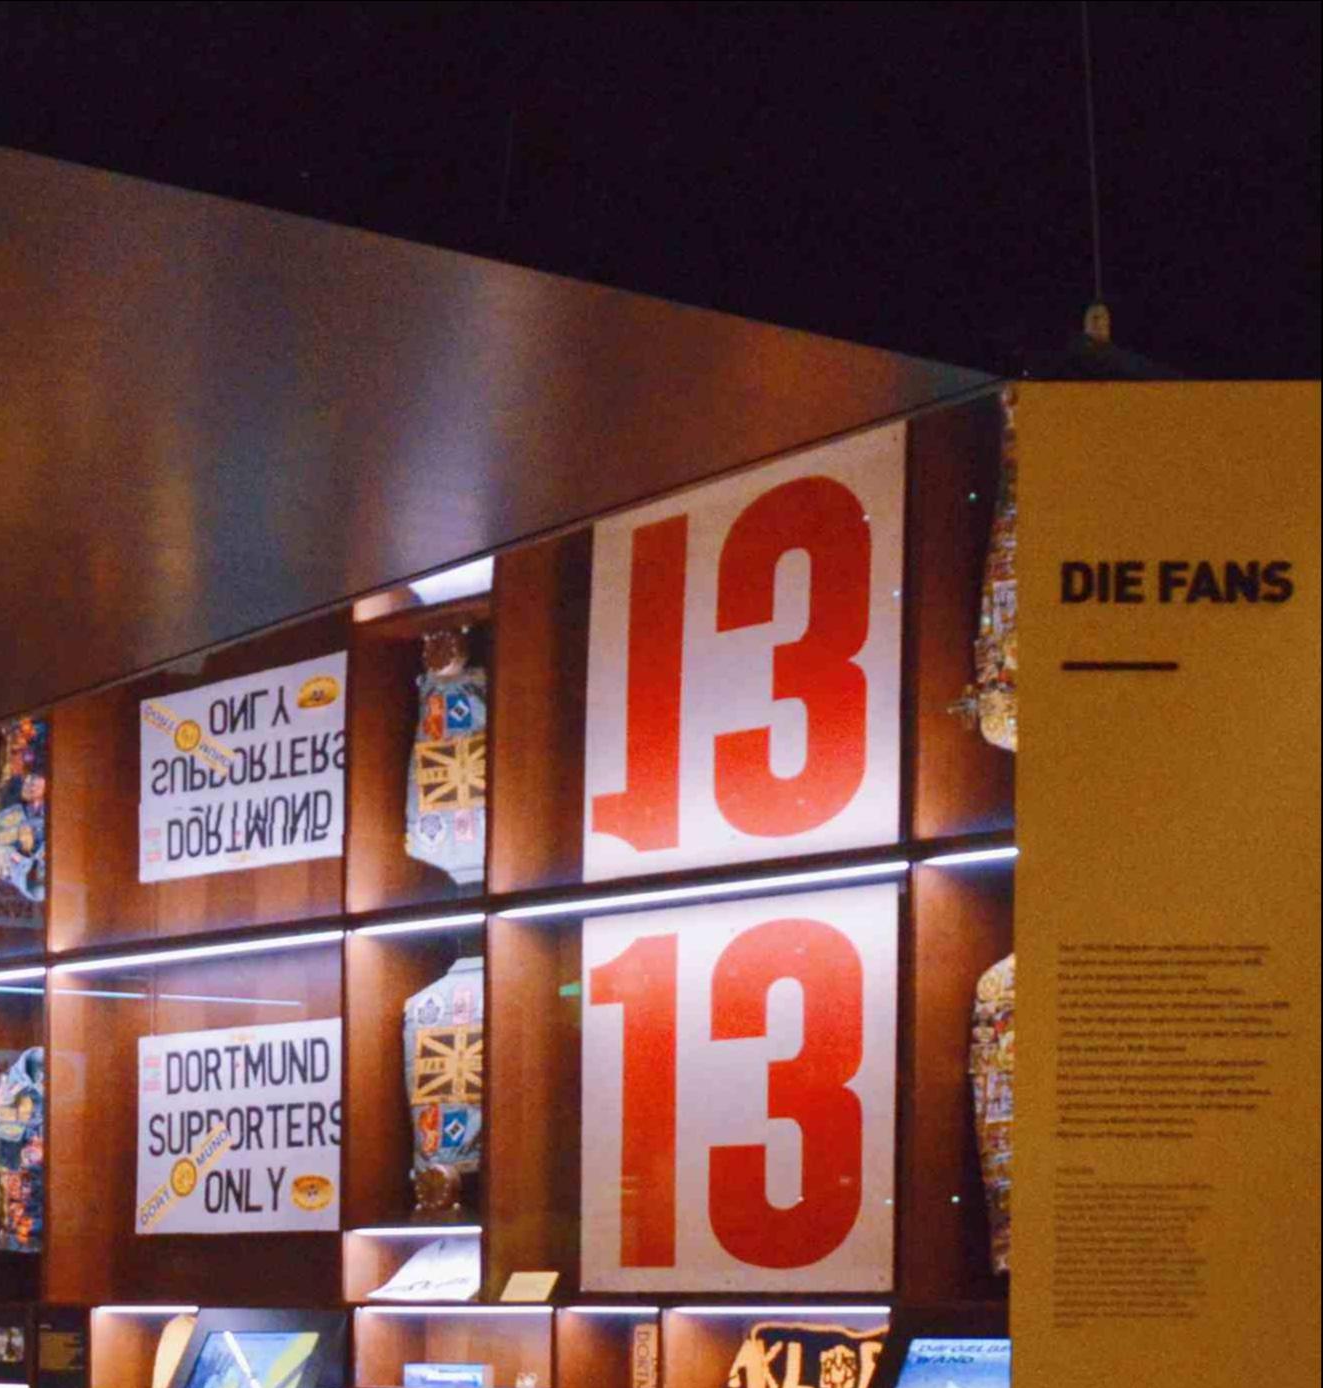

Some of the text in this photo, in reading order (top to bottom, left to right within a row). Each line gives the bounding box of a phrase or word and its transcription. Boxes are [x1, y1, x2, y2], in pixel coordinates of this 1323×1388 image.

[1061, 561, 1295, 603] DIE FANS
[166, 1037, 330, 1095] DORTMUND
[589, 917, 864, 1269] 13
[204, 1166, 288, 1215] ONLY
